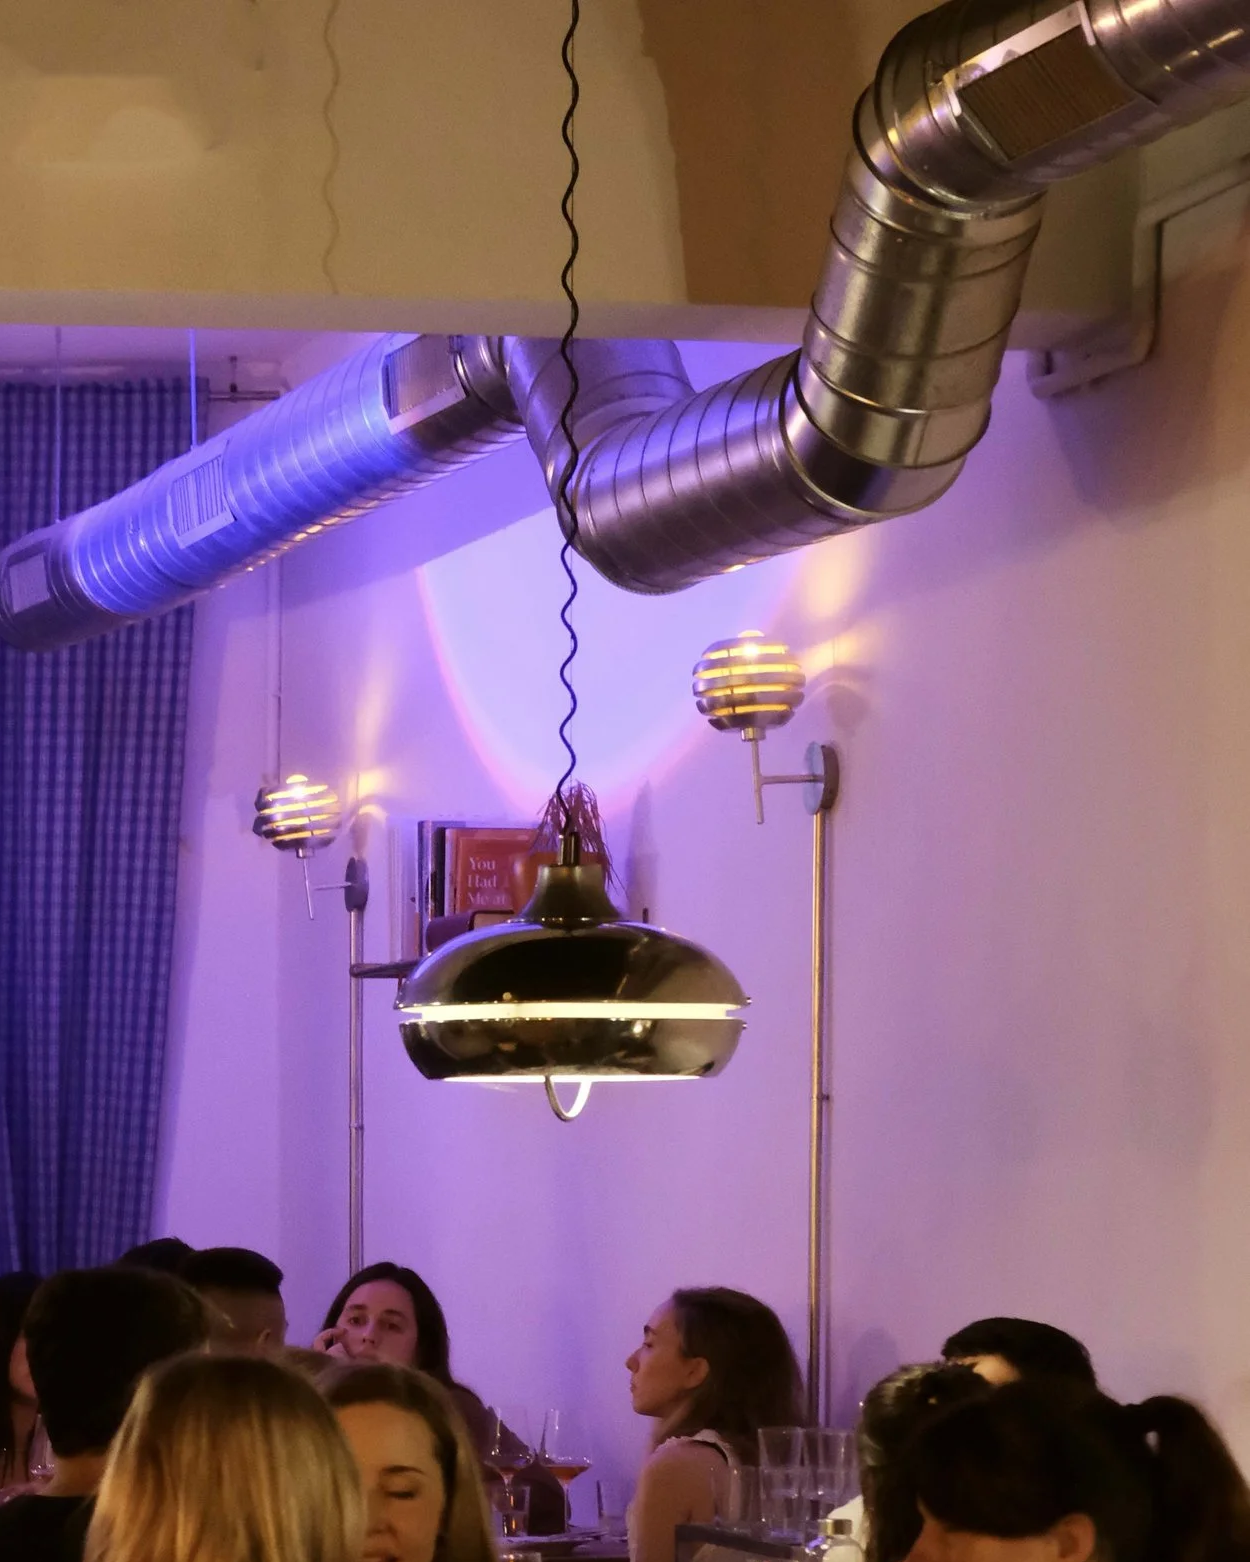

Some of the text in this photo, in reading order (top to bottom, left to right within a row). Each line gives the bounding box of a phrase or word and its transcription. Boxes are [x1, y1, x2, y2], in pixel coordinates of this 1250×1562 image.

[469, 856, 496, 871] You
[467, 874, 497, 888] Had
[467, 891, 488, 905] Me
